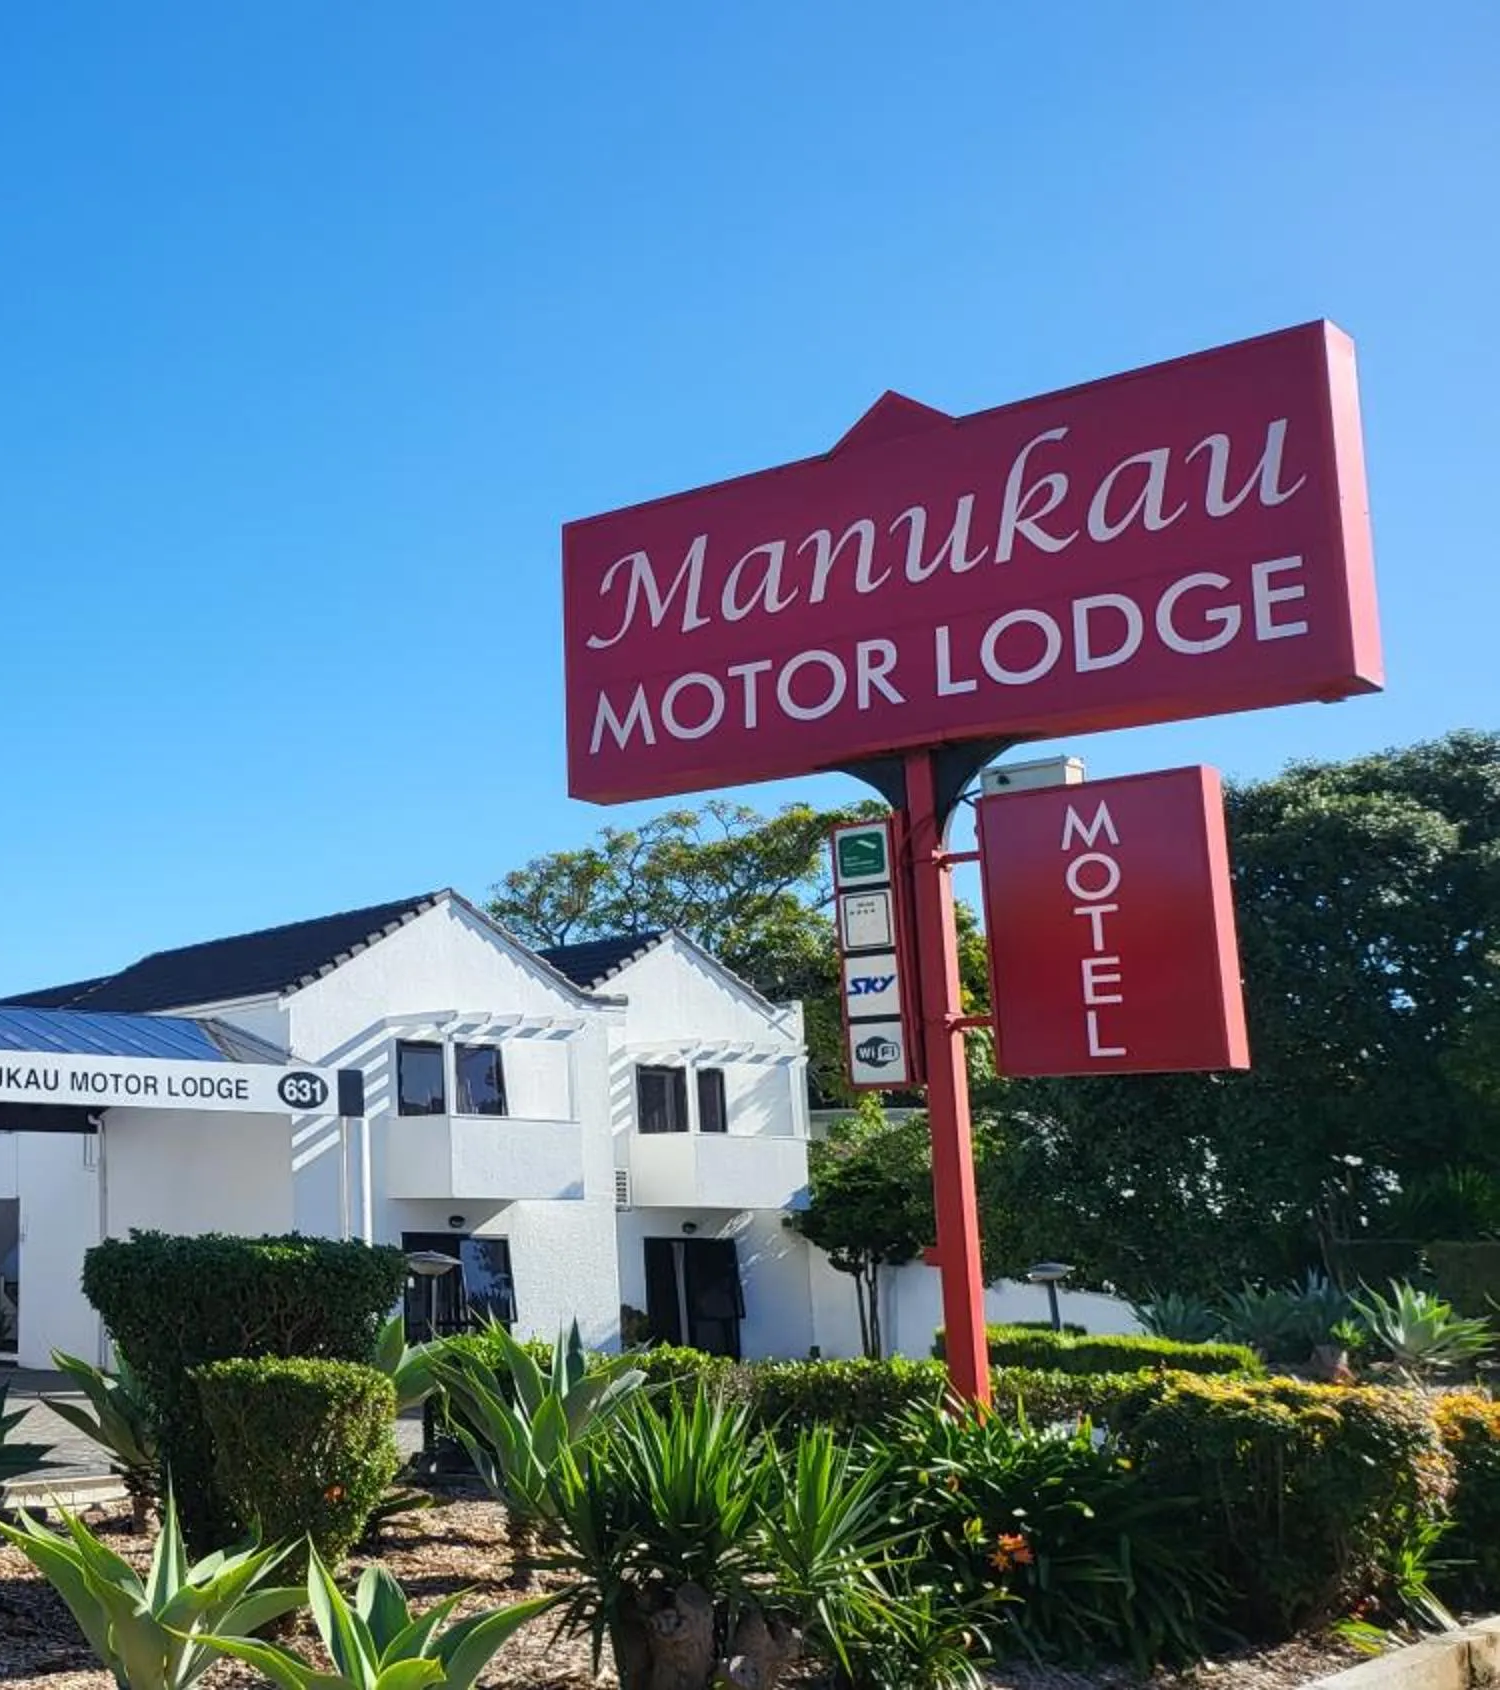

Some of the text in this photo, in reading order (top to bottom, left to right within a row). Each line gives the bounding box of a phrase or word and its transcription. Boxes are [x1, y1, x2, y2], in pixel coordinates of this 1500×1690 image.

[586, 418, 1305, 649] Manukau
[590, 555, 1308, 754] MOTOR LODGE
[847, 974, 896, 995] SKY
[1060, 800, 1126, 1057] MOTEL
[70, 1071, 158, 1096] MOTOR
[167, 1076, 249, 1100] LODGE
[283, 1078, 322, 1102] 631
